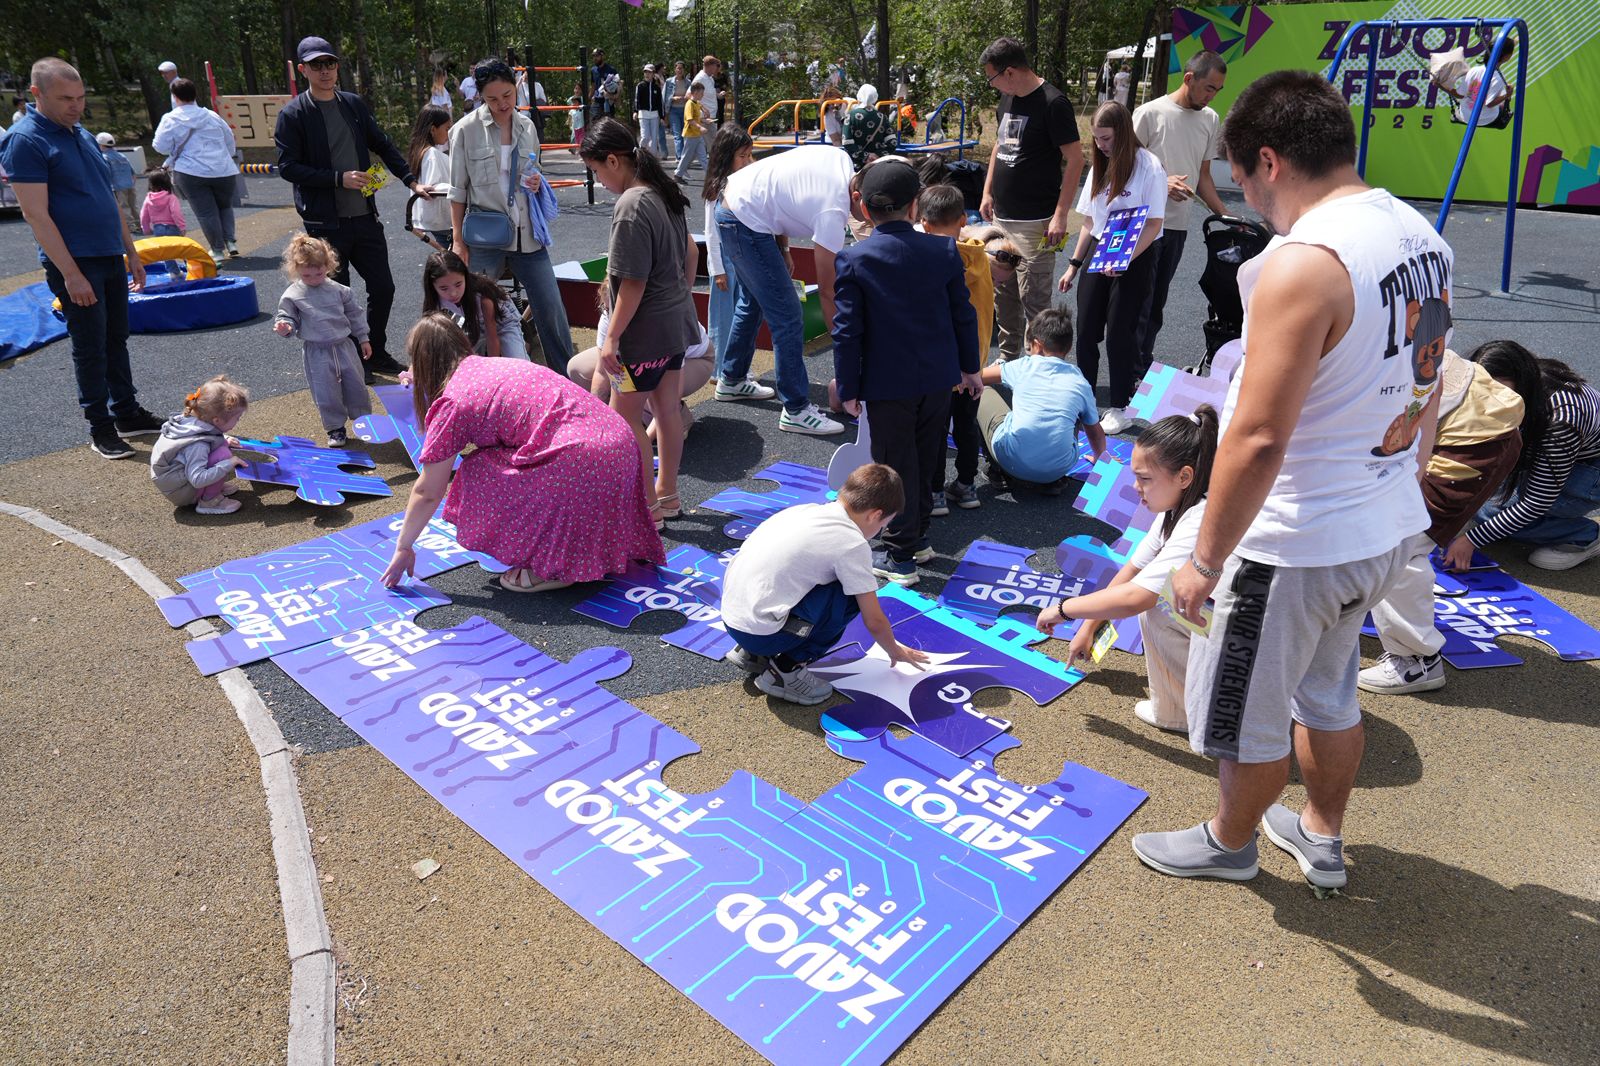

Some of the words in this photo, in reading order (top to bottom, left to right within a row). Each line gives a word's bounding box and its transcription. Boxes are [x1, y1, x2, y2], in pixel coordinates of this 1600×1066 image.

[261, 588, 320, 627] FEST
[625, 586, 727, 631] AVOD
[996, 570, 1084, 597] FEST
[215, 590, 287, 649] ZAVOD
[1231, 593, 1266, 640] YOUR
[332, 630, 417, 681] ZAVO
[470, 684, 559, 736] FEST
[1211, 642, 1253, 743] STRENGTHS
[418, 692, 538, 771] ZAVOD
[544, 779, 692, 878] ZAVOD
[601, 769, 709, 834] FEST
[883, 778, 1056, 873] ZAVOD
[935, 768, 1054, 831] FEST
[779, 879, 912, 965] FEST
[715, 893, 905, 1025] ZAVOD
